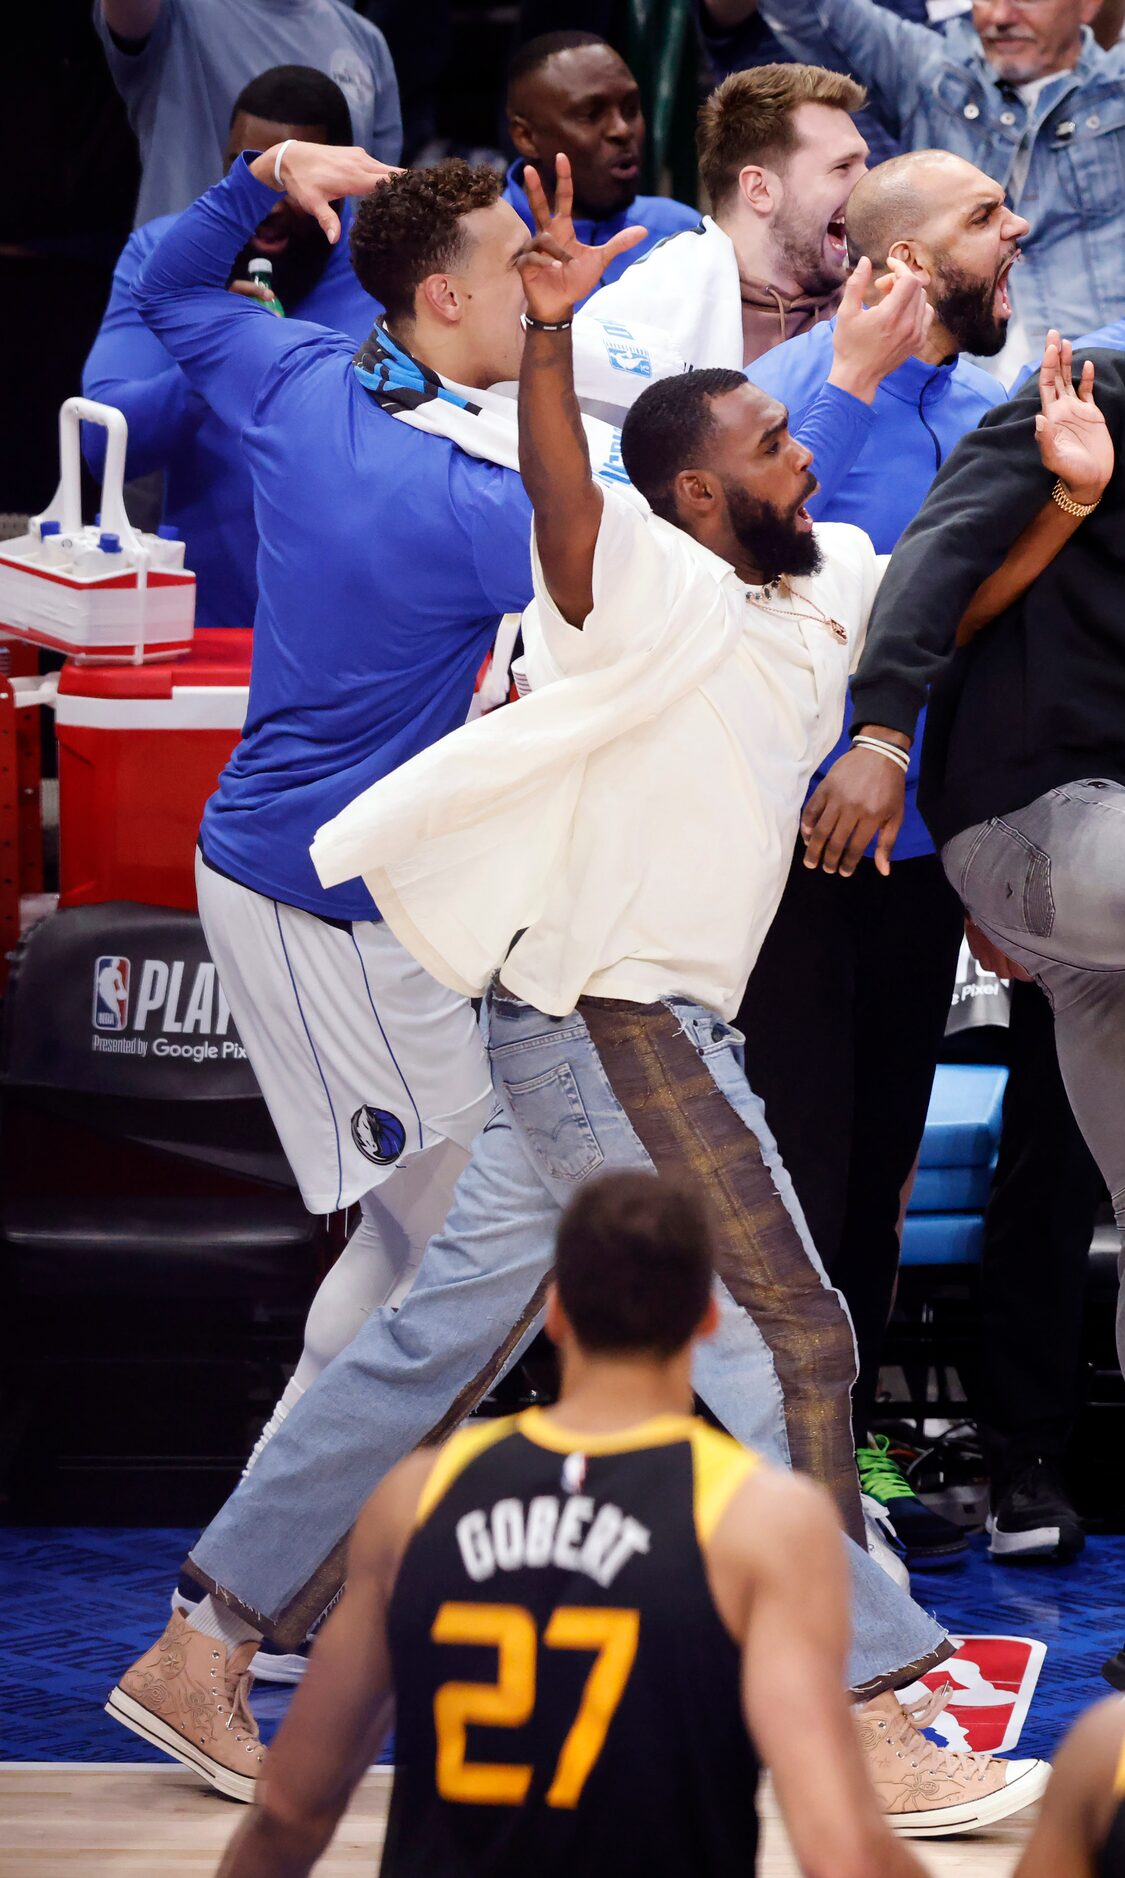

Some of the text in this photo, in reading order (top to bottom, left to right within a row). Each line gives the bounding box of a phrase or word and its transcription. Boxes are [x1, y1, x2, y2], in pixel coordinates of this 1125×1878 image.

[92, 1034, 137, 1055] Presented
[137, 1037, 148, 1058] by
[152, 1038, 218, 1063] Google
[456, 1495, 651, 1588] GOBERT
[431, 1601, 640, 1809] 27
